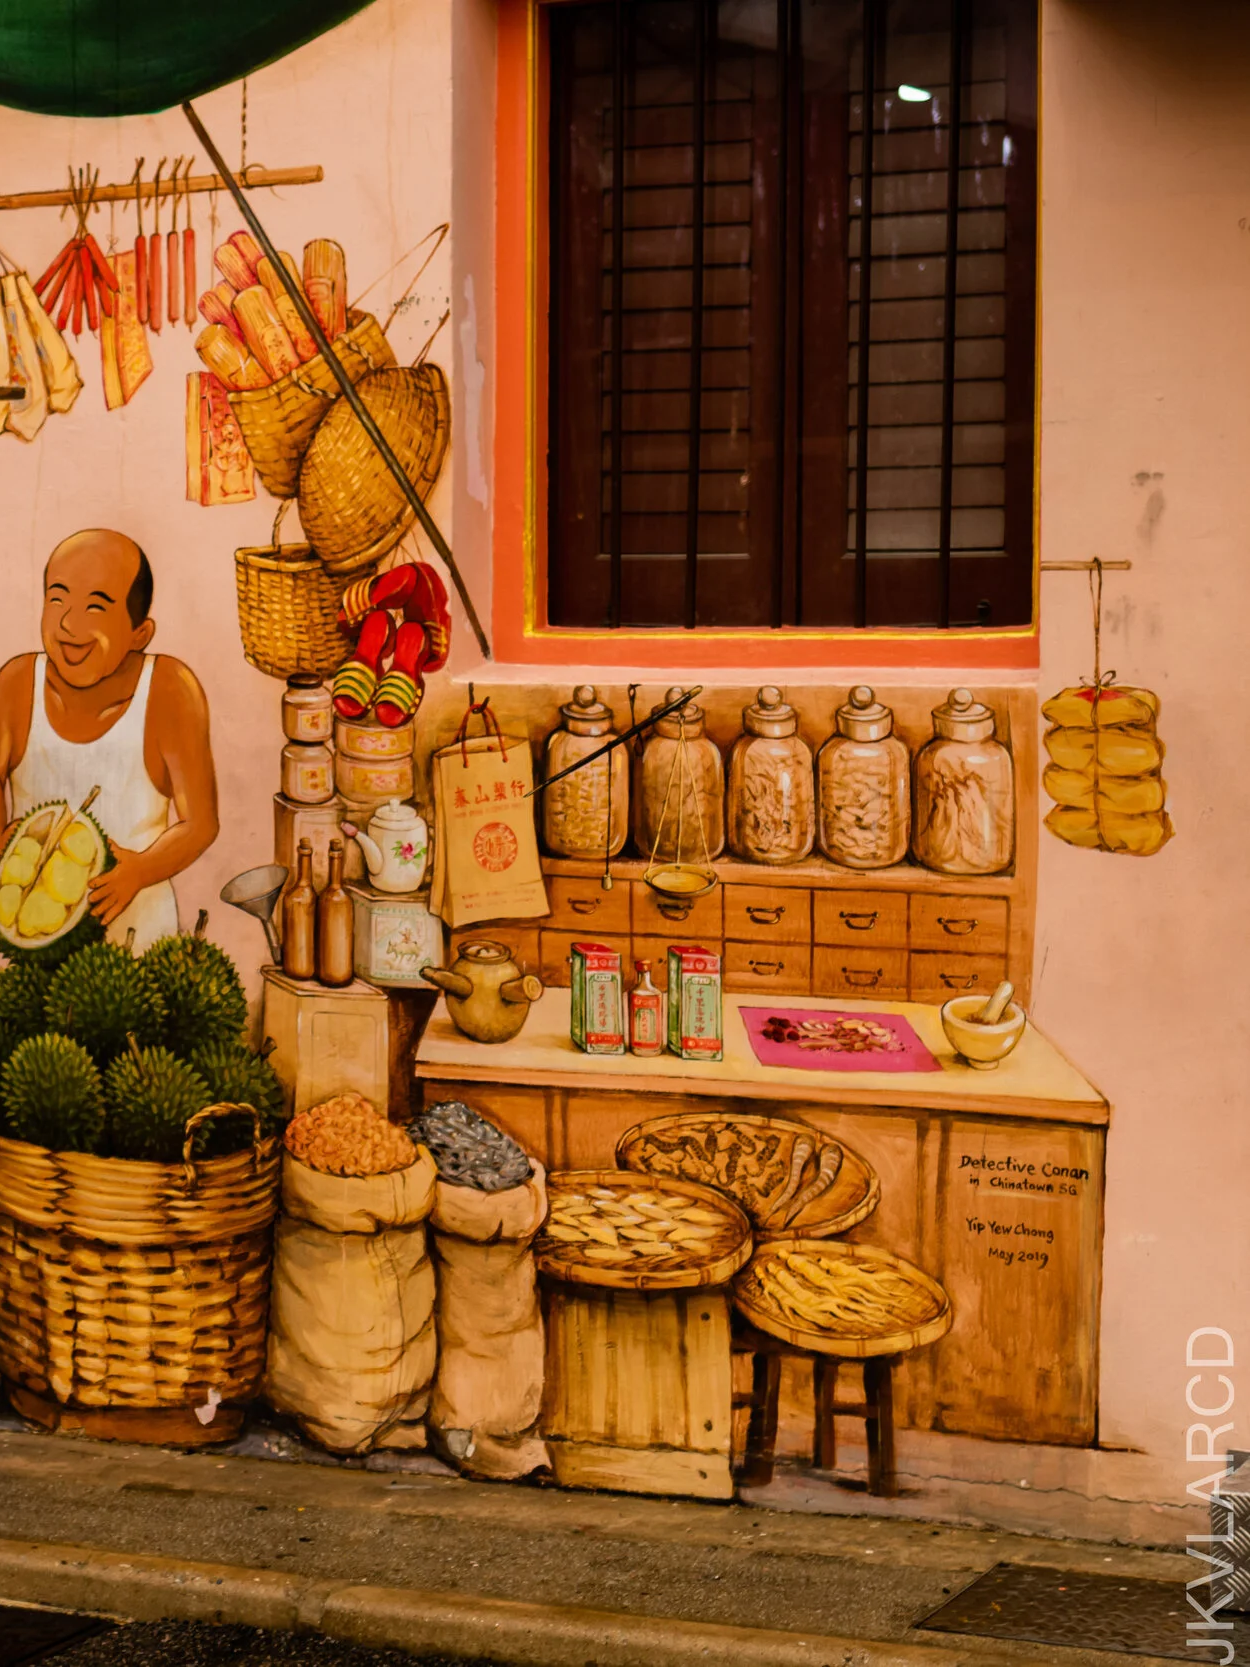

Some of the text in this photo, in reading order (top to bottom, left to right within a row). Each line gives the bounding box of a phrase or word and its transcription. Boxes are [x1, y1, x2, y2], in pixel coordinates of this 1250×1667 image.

[958, 1155, 1090, 1180] Detective Conan
[969, 1174, 1078, 1196] in Chinatown SG
[966, 1217, 1055, 1244] Yip Yew Chong
[988, 1247, 1049, 1270] May 2019
